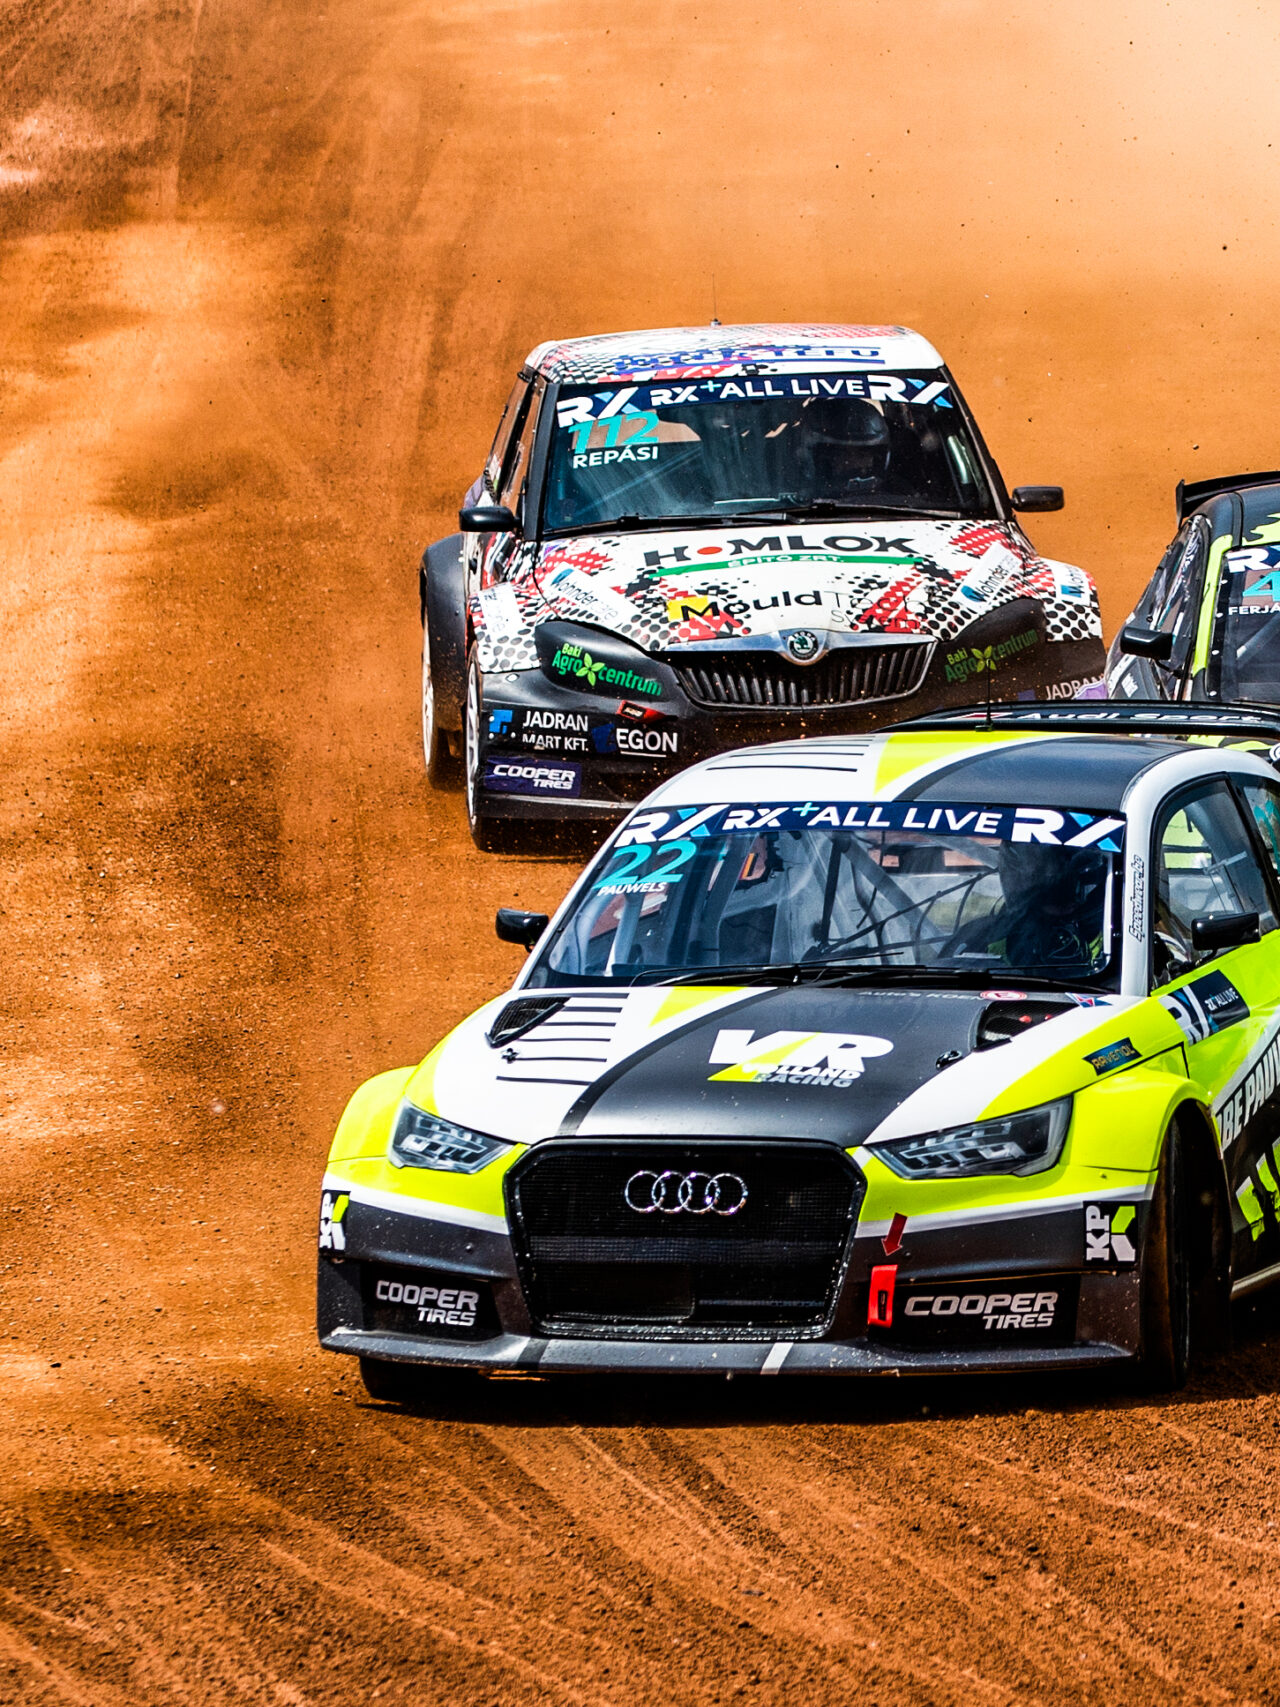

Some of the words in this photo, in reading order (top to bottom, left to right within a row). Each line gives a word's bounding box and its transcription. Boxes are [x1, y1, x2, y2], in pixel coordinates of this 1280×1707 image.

[793, 379, 865, 396] LIVE
[867, 375, 953, 408] RX
[557, 387, 642, 427] RX
[568, 411, 660, 454] 112
[573, 444, 658, 469] REPÁSI
[523, 711, 588, 732] JADRAN
[523, 734, 561, 750] MART
[616, 728, 678, 752] EGON
[493, 764, 576, 781] COOPER
[533, 779, 573, 790] TIRES
[614, 804, 731, 848] RX
[903, 807, 1003, 834] LIVE
[1011, 808, 1126, 853] RX
[593, 840, 697, 889] 22
[597, 881, 667, 896] PAUWELS
[1085, 1205, 1110, 1261] KP
[376, 1280, 479, 1311] COOPER
[904, 1292, 1058, 1316] COOPER
[417, 1307, 477, 1326] TIRES
[982, 1312, 1054, 1331] TIRES
